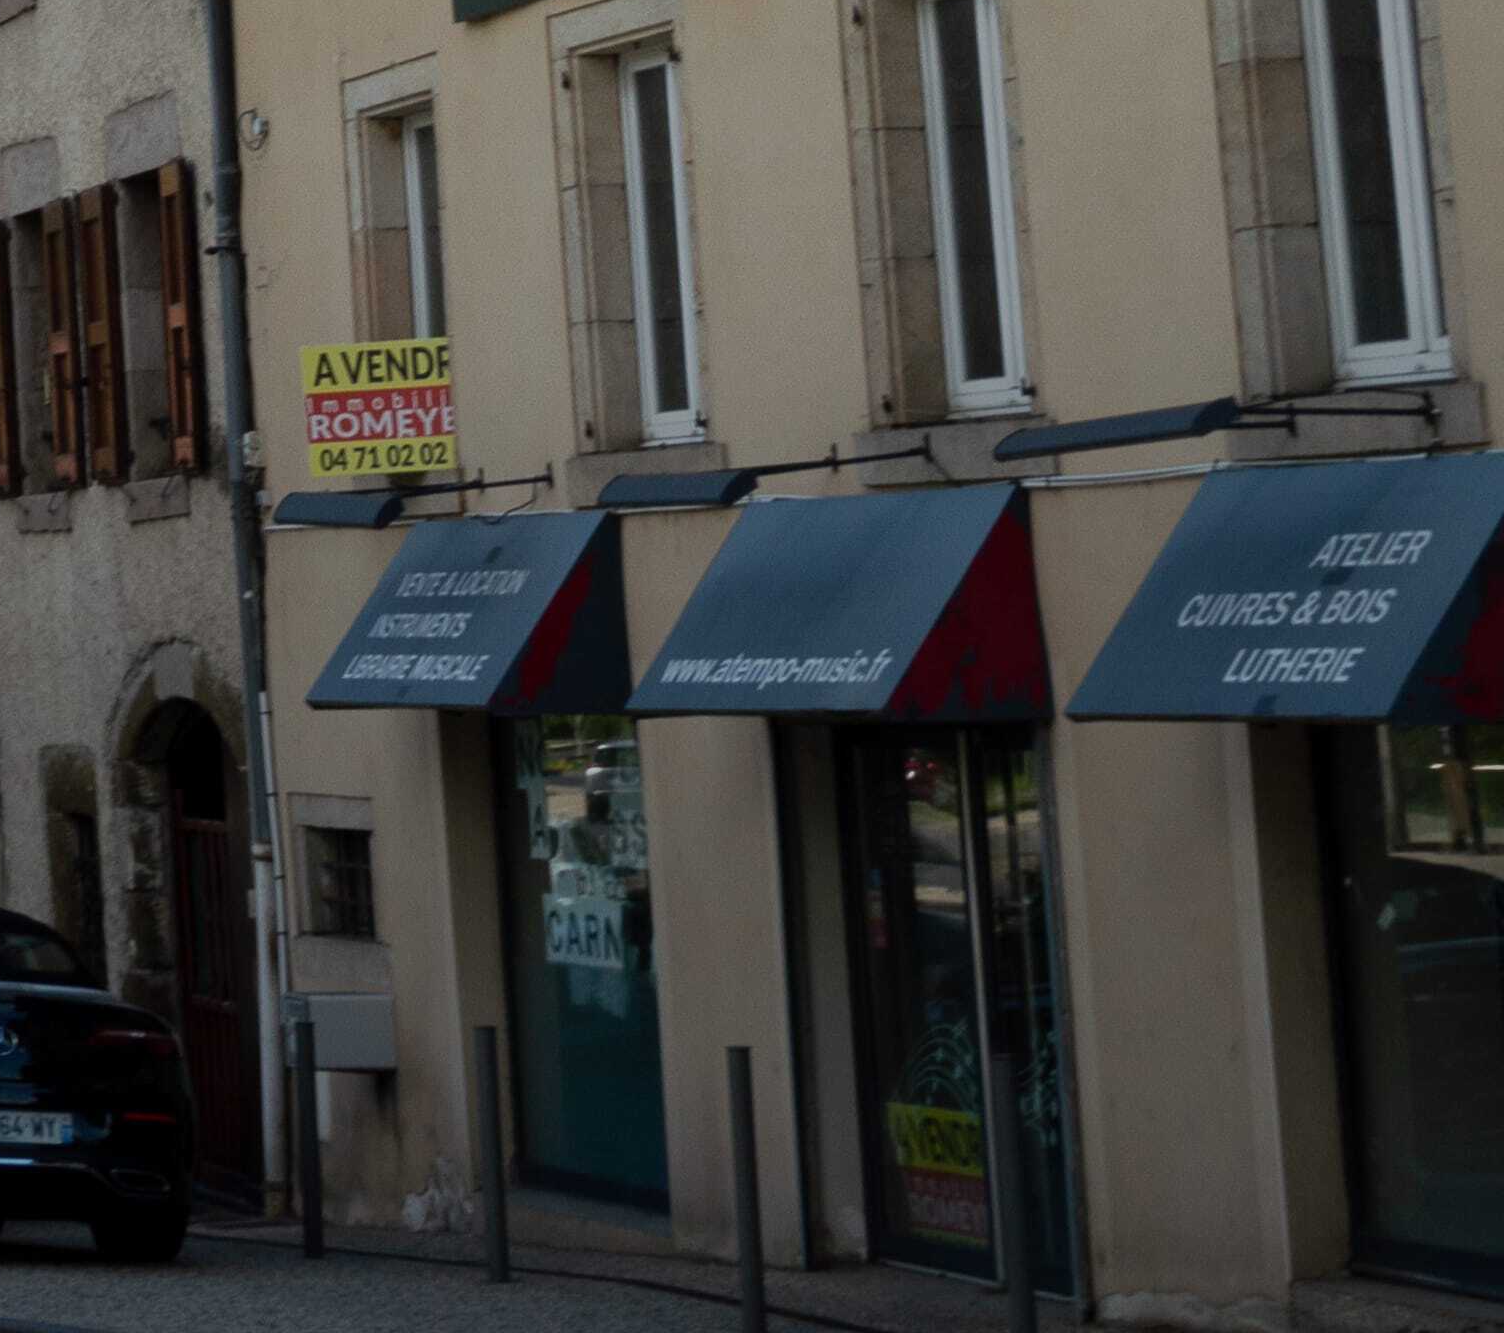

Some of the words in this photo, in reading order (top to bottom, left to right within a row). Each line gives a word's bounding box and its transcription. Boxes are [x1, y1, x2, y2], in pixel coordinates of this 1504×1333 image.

[320, 448, 348, 471] 04
[353, 446, 380, 469] 71
[1308, 529, 1432, 568] ATELIER
[1177, 591, 1296, 627] CUIVRES
[1291, 590, 1321, 625] &
[1319, 588, 1398, 624] BOIS
[1221, 647, 1367, 683] LUTHERIE
